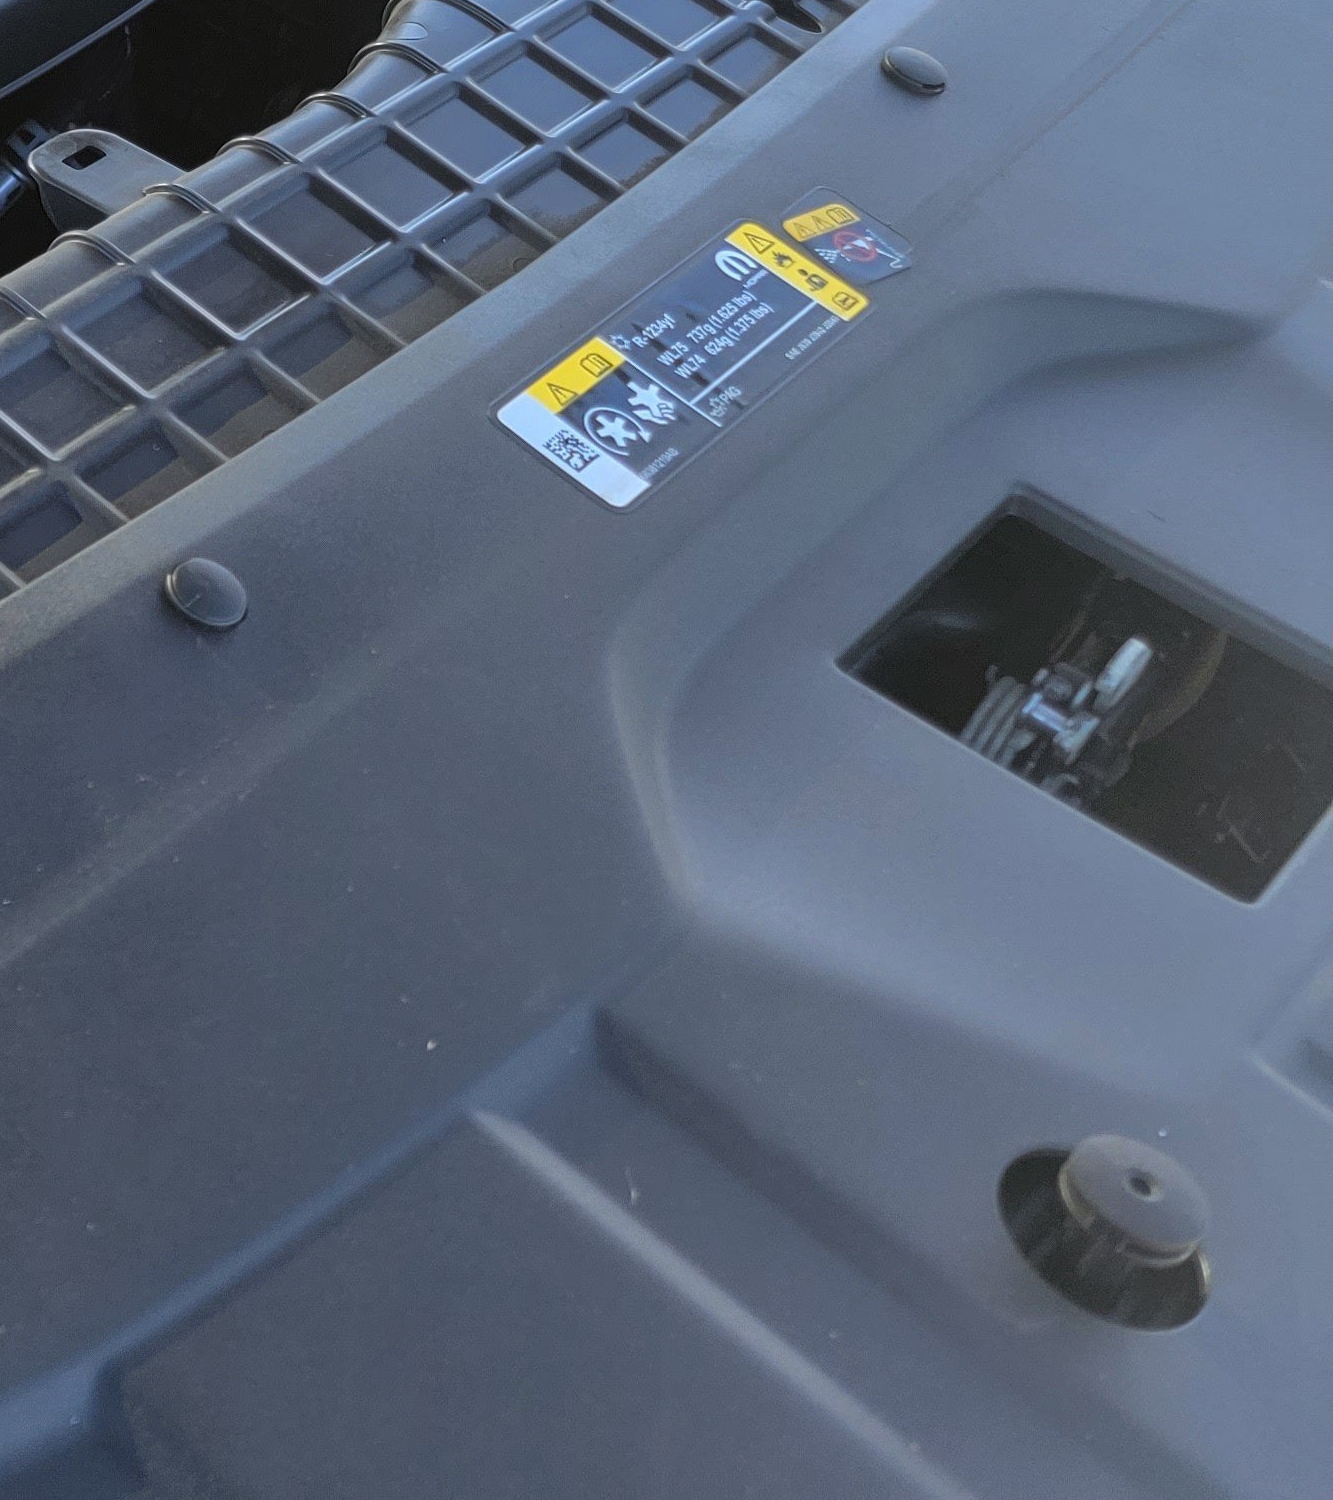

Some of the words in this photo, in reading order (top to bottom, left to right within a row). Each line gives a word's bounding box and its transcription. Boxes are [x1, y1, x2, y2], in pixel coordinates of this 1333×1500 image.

[657, 341, 689, 366] WL75
[686, 325, 717, 344] 737g
[708, 302, 739, 330] (1.625
[731, 290, 757, 310] lbs)
[674, 354, 707, 379] WL74
[704, 336, 735, 356] 624g
[725, 313, 756, 341] (1.375
[749, 301, 775, 320] lbs)
